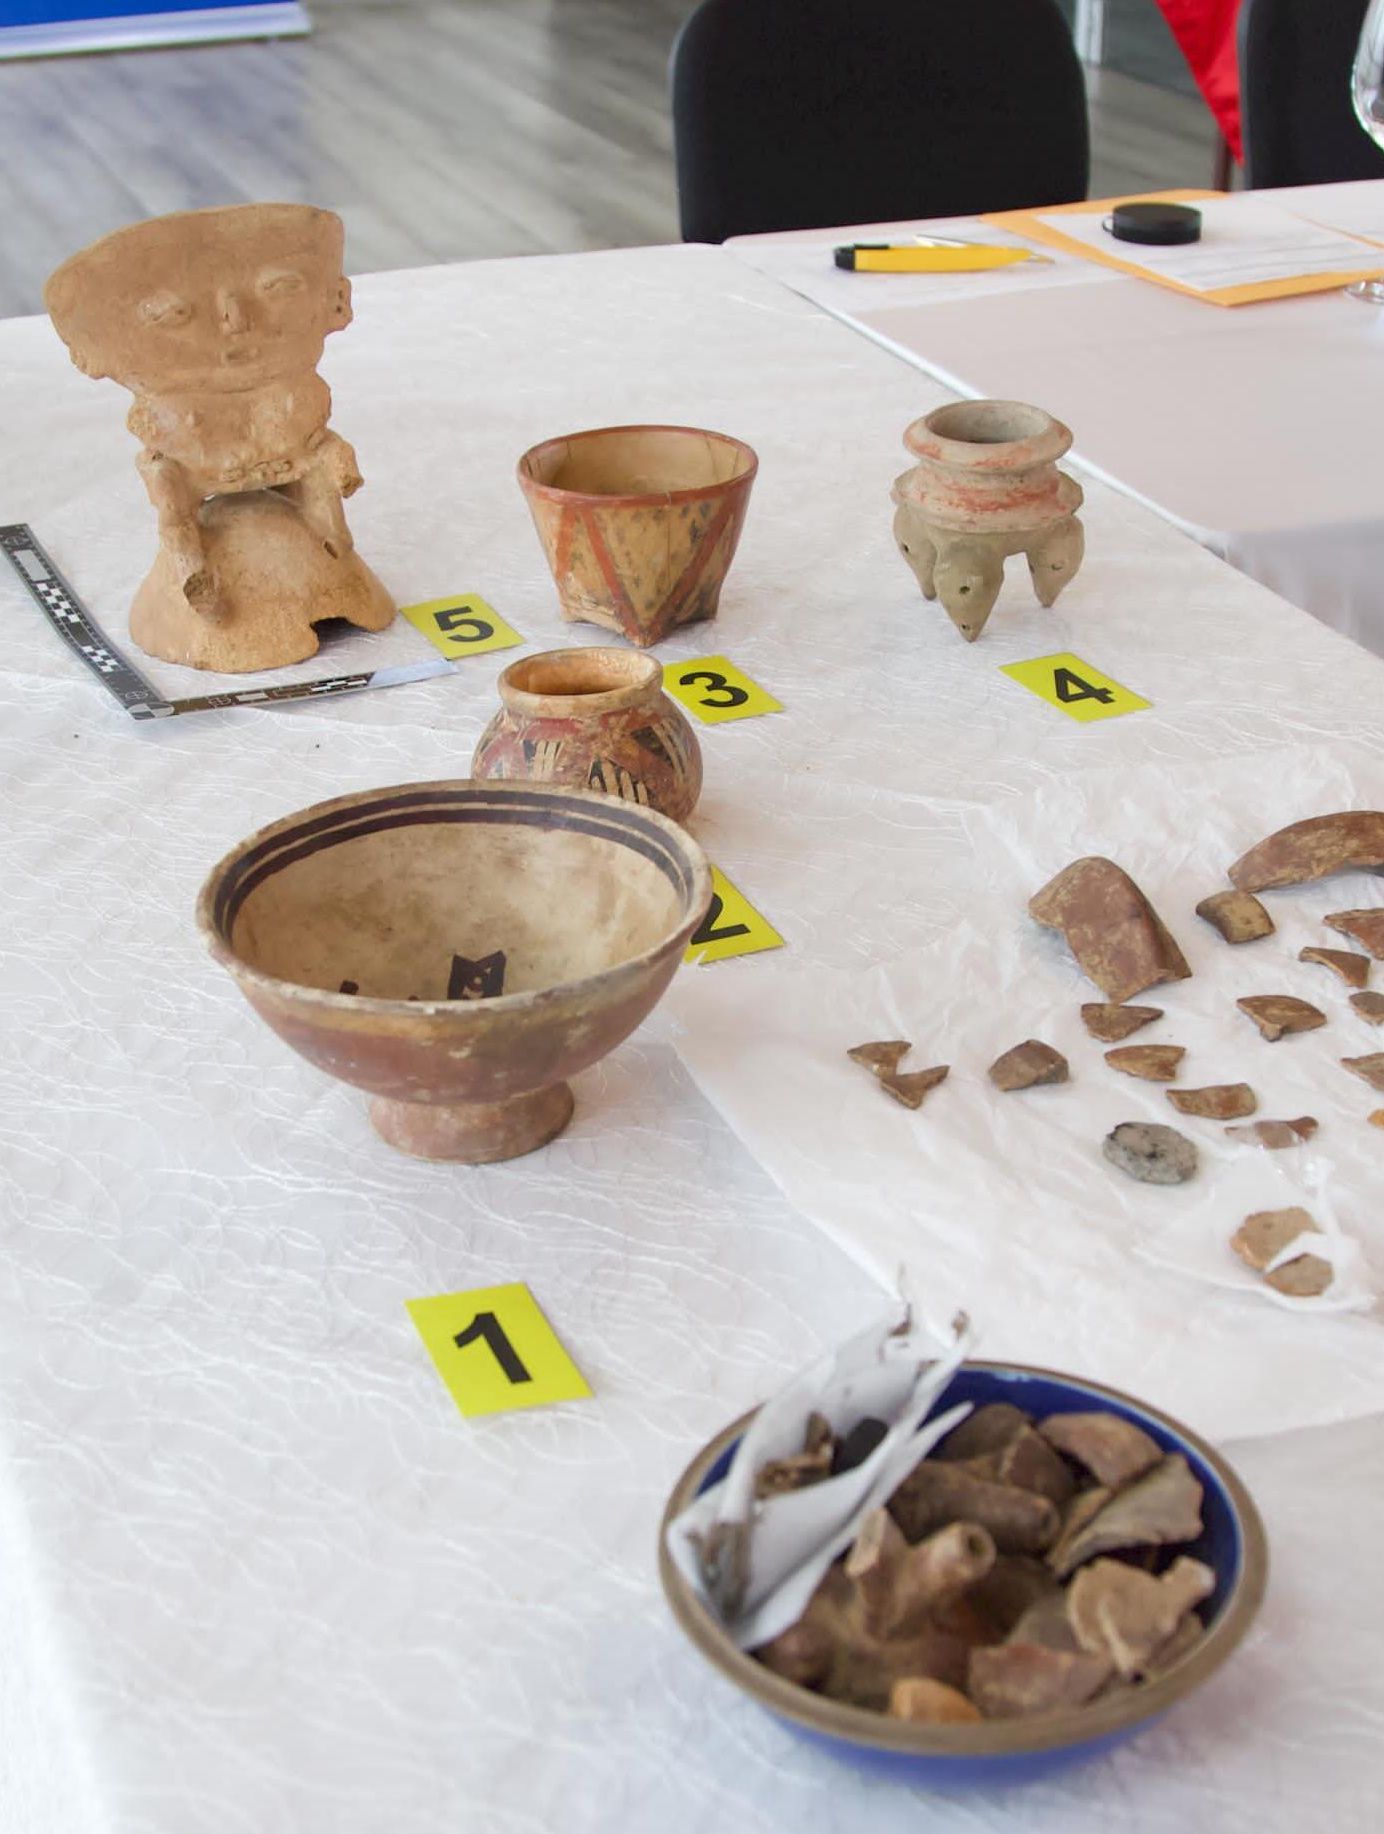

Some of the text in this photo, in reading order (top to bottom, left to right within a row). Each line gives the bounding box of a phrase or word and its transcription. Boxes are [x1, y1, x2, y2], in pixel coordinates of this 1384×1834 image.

[433, 605, 494, 643] 5
[679, 671, 749, 708] 3
[1053, 667, 1115, 705] 4
[690, 891, 752, 946] 2
[453, 1311, 533, 1385] 1
